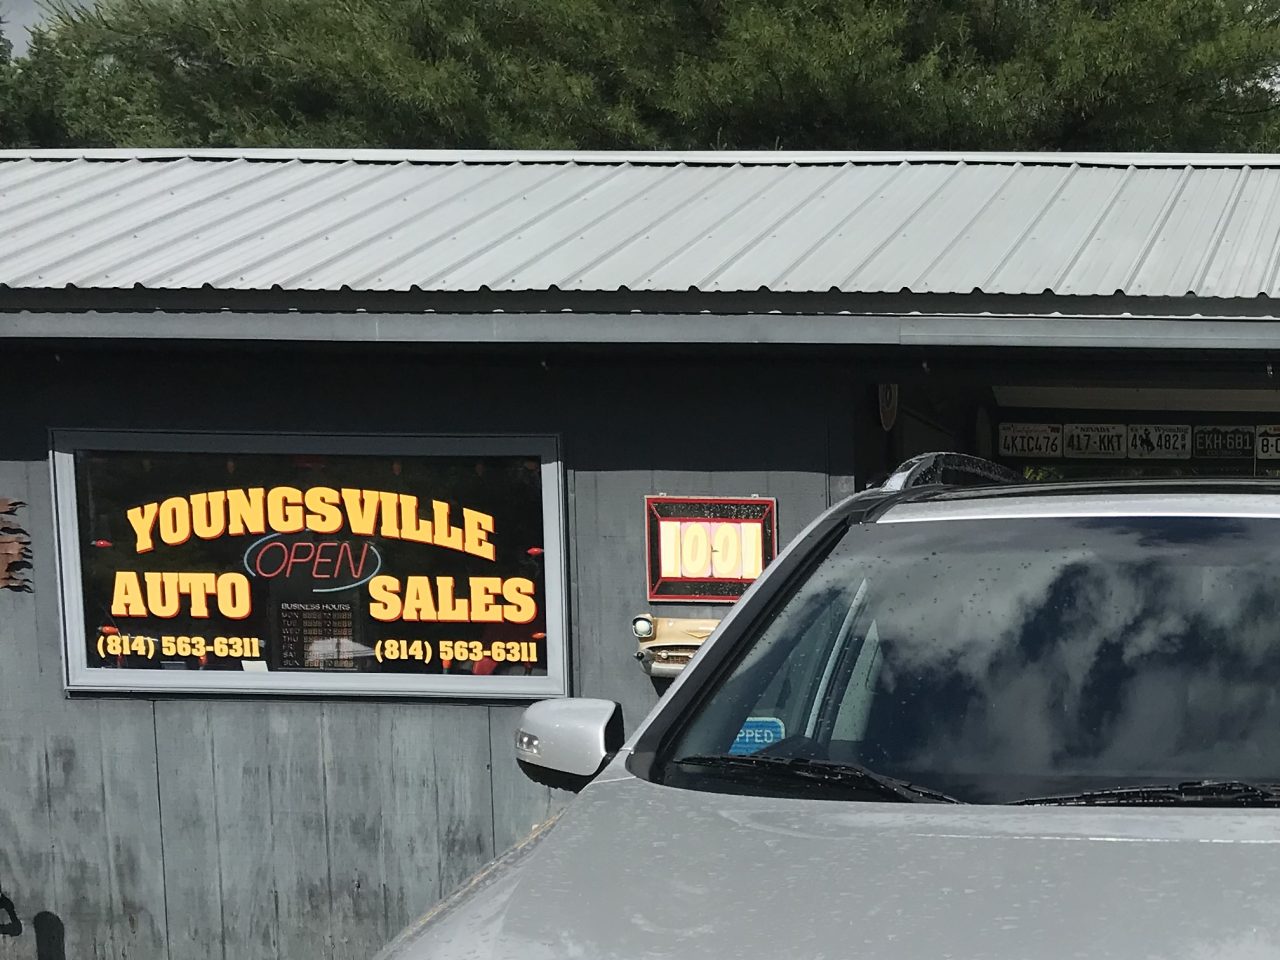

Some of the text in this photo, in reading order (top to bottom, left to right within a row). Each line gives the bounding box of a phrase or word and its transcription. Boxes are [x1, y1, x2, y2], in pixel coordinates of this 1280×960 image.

[1003, 435, 1058, 452] 4KIC476
[127, 486, 496, 562] YOUNGSVILLE
[255, 542, 369, 580] OPEN
[662, 522, 762, 577] 1001
[111, 571, 538, 624] AUTO SALES
[97, 635, 260, 660] (814) 563-6311
[375, 639, 538, 664] (814) 563-6311
